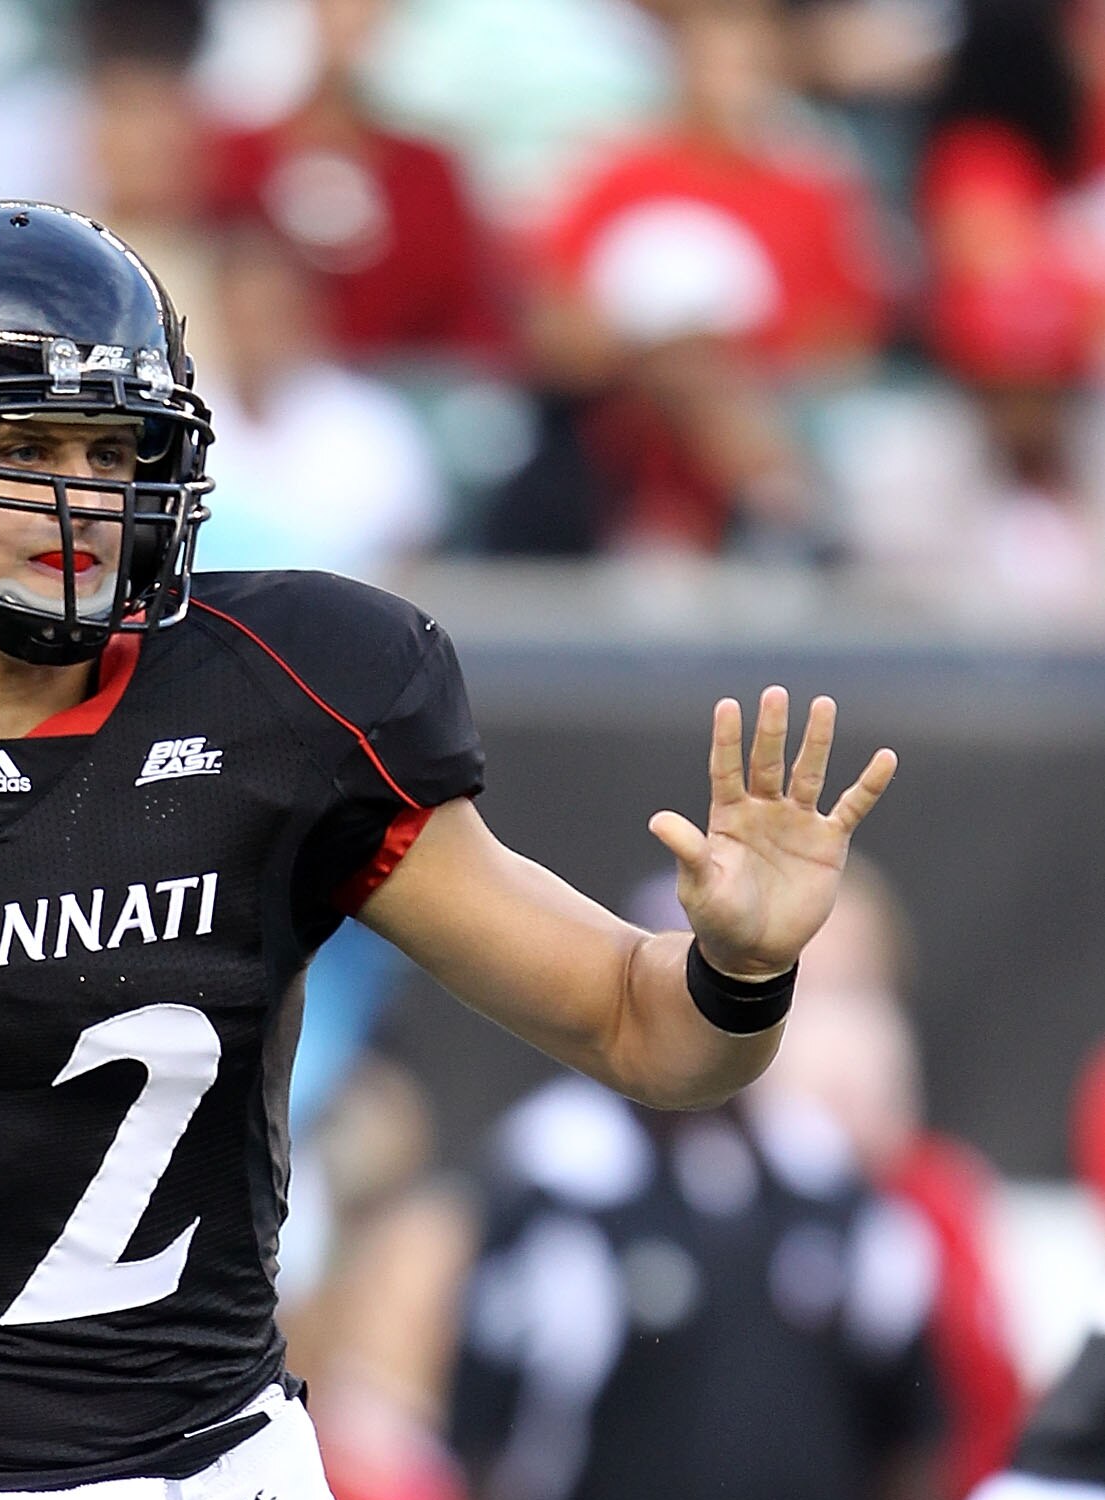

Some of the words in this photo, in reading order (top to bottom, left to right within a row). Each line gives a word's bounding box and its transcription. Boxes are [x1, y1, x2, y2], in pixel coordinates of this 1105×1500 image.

[91, 344, 125, 358] BIG
[83, 355, 131, 371] EAST
[148, 737, 207, 760] BIG
[141, 750, 223, 777] EAST
